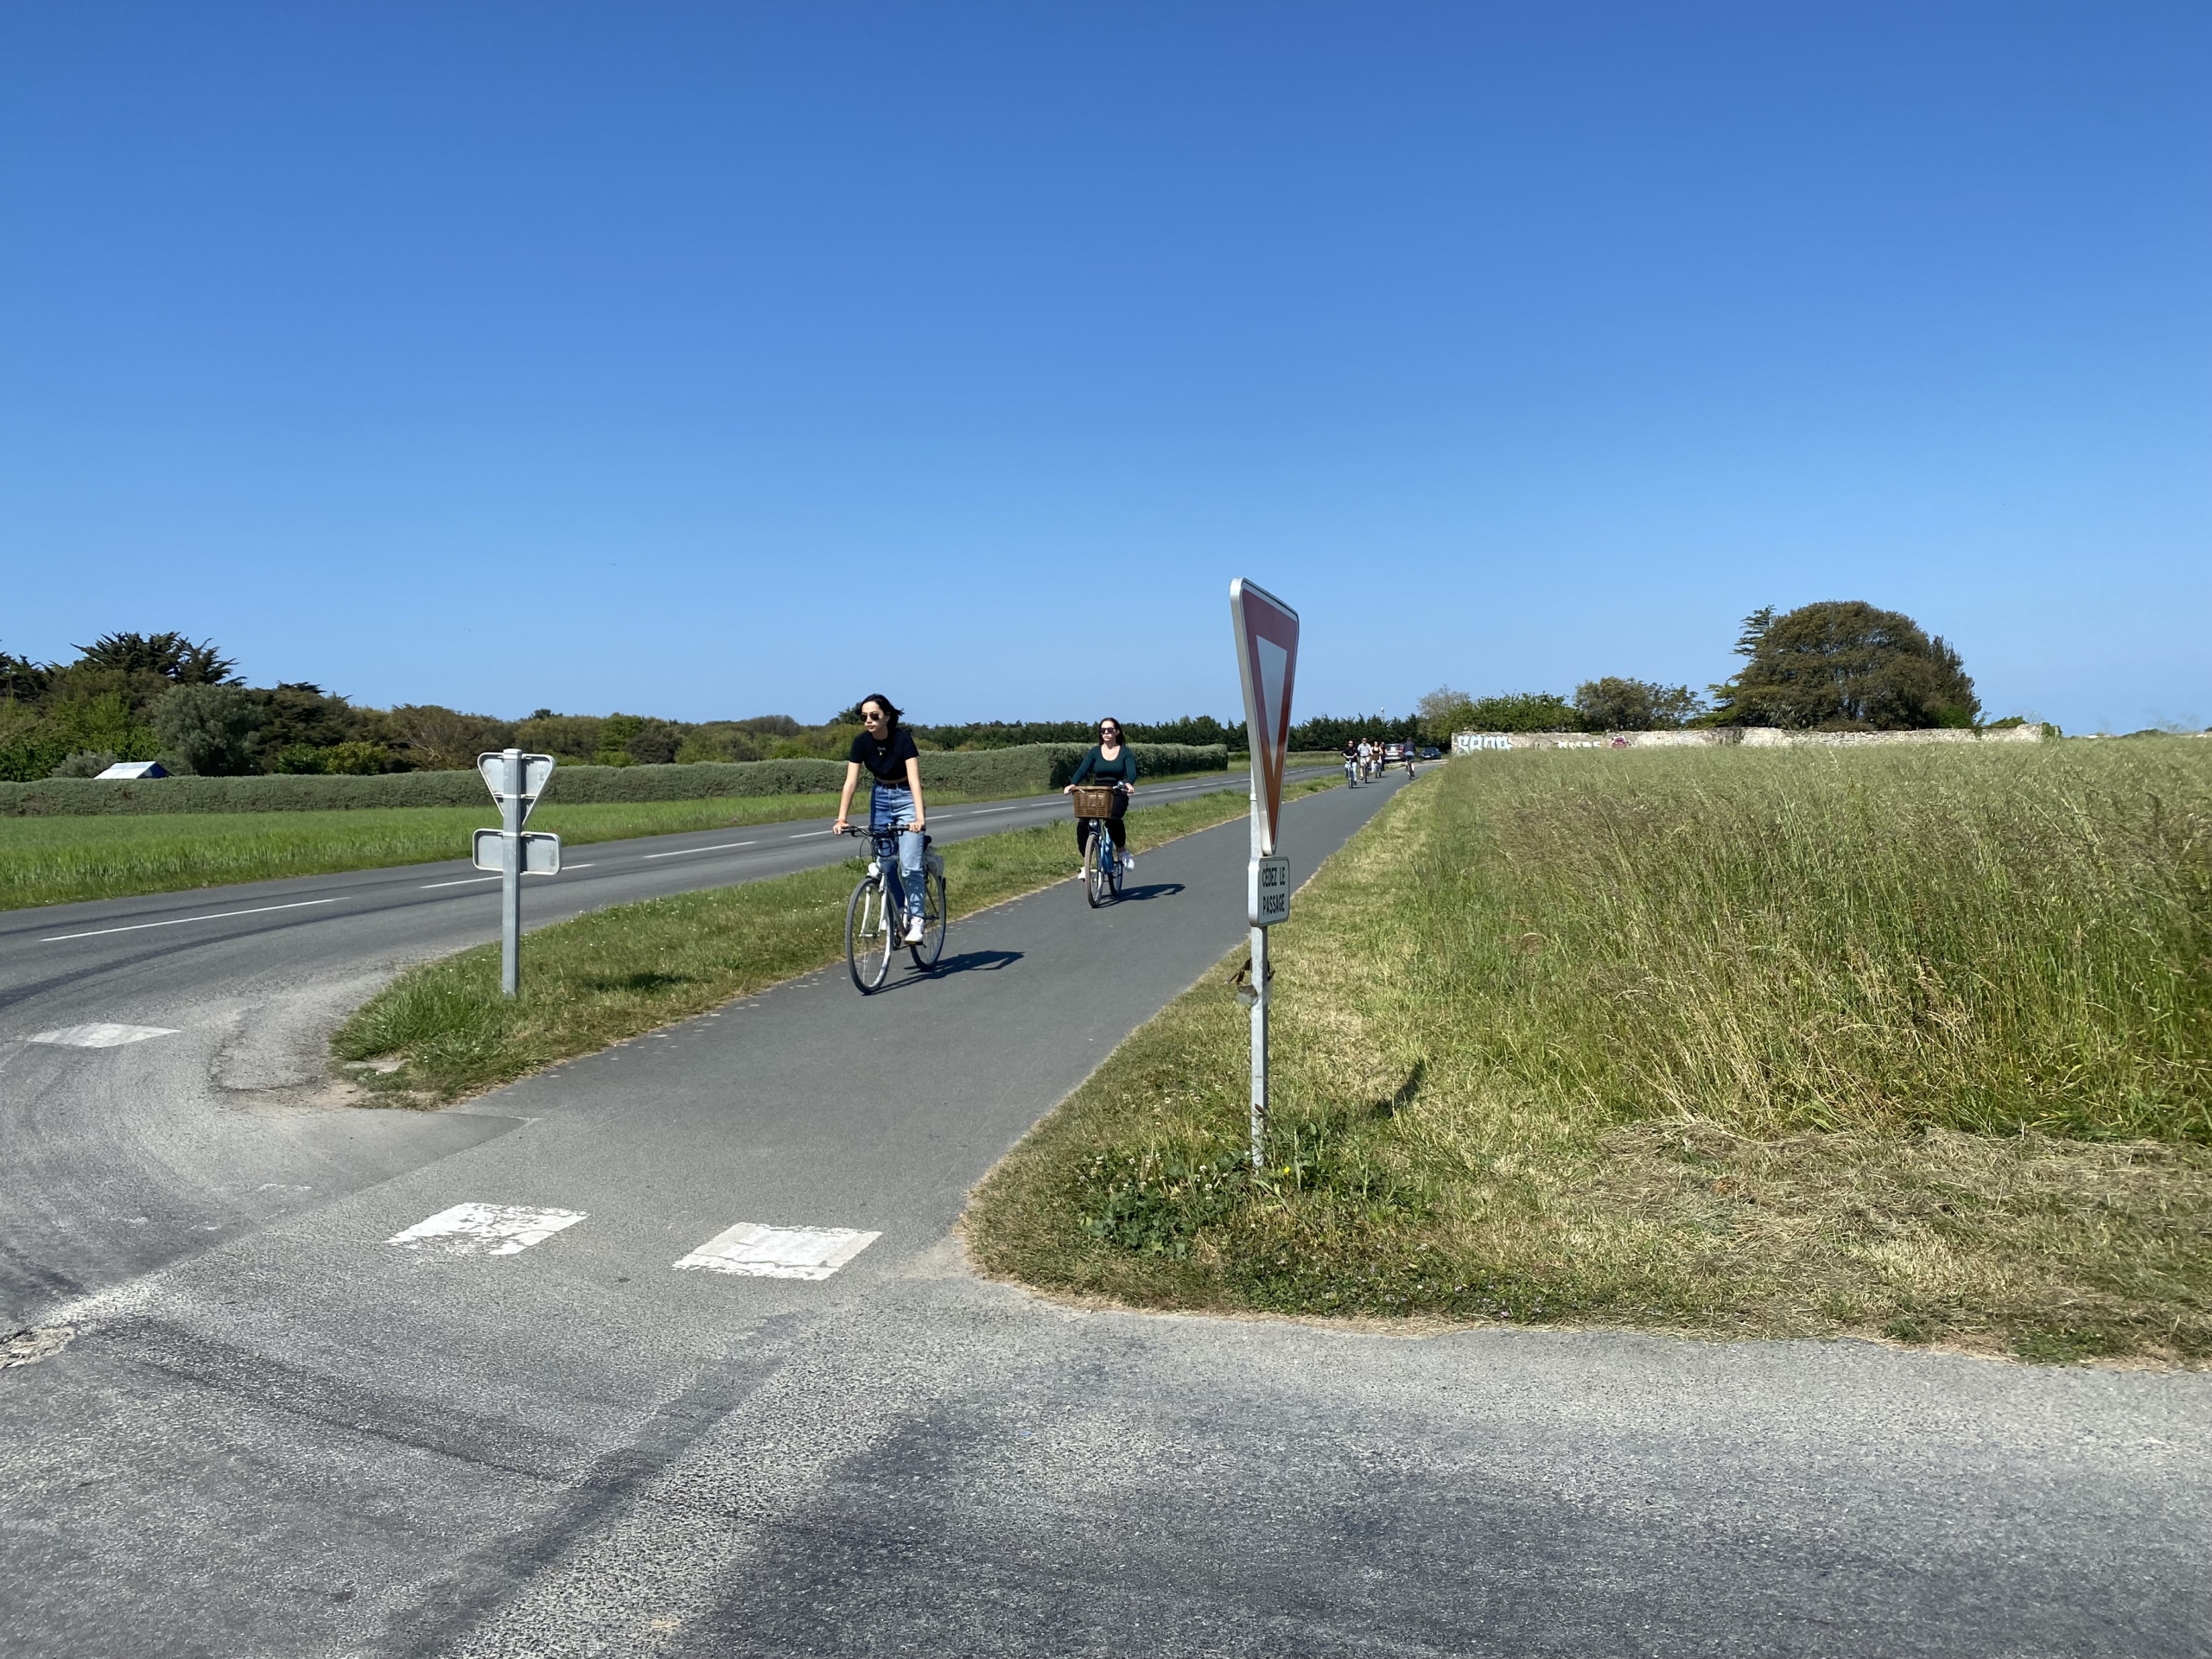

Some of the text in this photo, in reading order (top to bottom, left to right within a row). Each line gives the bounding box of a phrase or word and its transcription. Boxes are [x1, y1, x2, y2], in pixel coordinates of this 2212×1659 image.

[1262, 863, 1285, 887] CÉDEZ LE
[1262, 893, 1285, 916] PASSAGE
